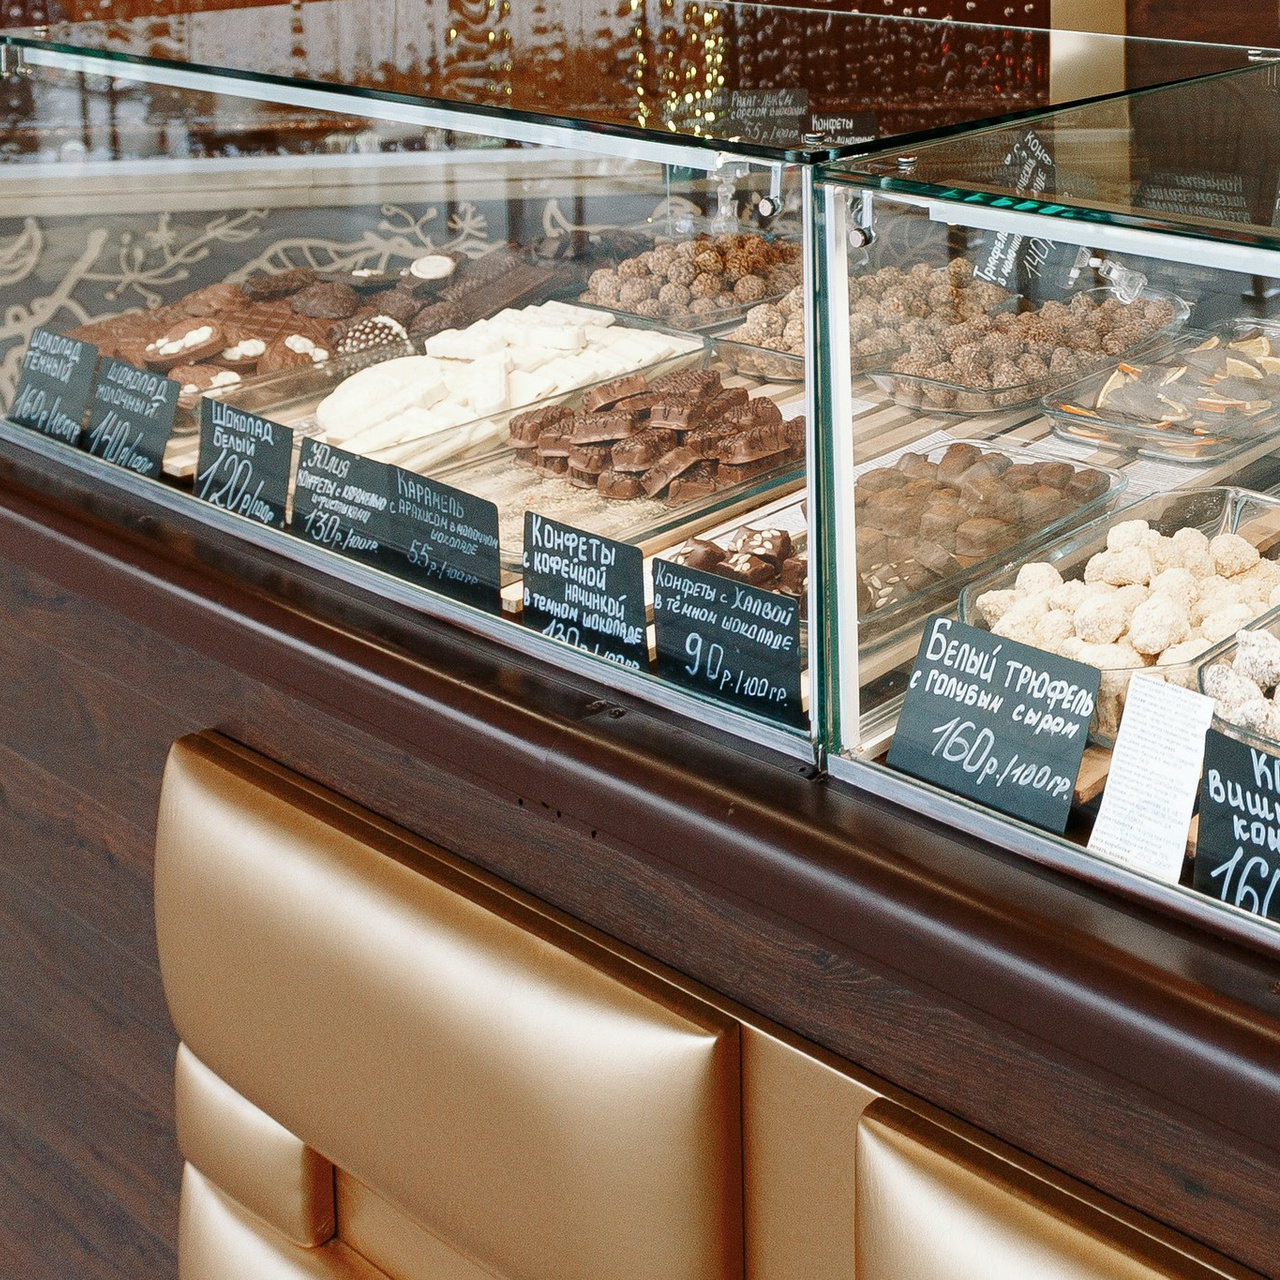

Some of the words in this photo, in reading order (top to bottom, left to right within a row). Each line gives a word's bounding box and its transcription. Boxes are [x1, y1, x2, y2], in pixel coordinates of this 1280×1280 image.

[31, 329, 83, 365] ШОКОЛАД
[106, 361, 168, 403] ШОКОЛАД
[211, 400, 275, 446] ШОКОЛАД
[213, 426, 257, 457] БЕЛЫЙ
[396, 467, 465, 519] КАРАМЕЛЬ
[531, 513, 616, 567] КОНФЕТЫ
[533, 551, 608, 592] КОФЕЙНОЙ
[655, 561, 717, 602] КОНФЕТЫ
[730, 585, 795, 627] ХАЛВОЙ
[564, 582, 628, 621] НАЧИНКОЙ
[925, 617, 1003, 684] БЕЛЫЙ
[1003, 660, 1096, 718] ТРЮФЕЛЬ
[924, 669, 1005, 714] ГОЛУБЫМ
